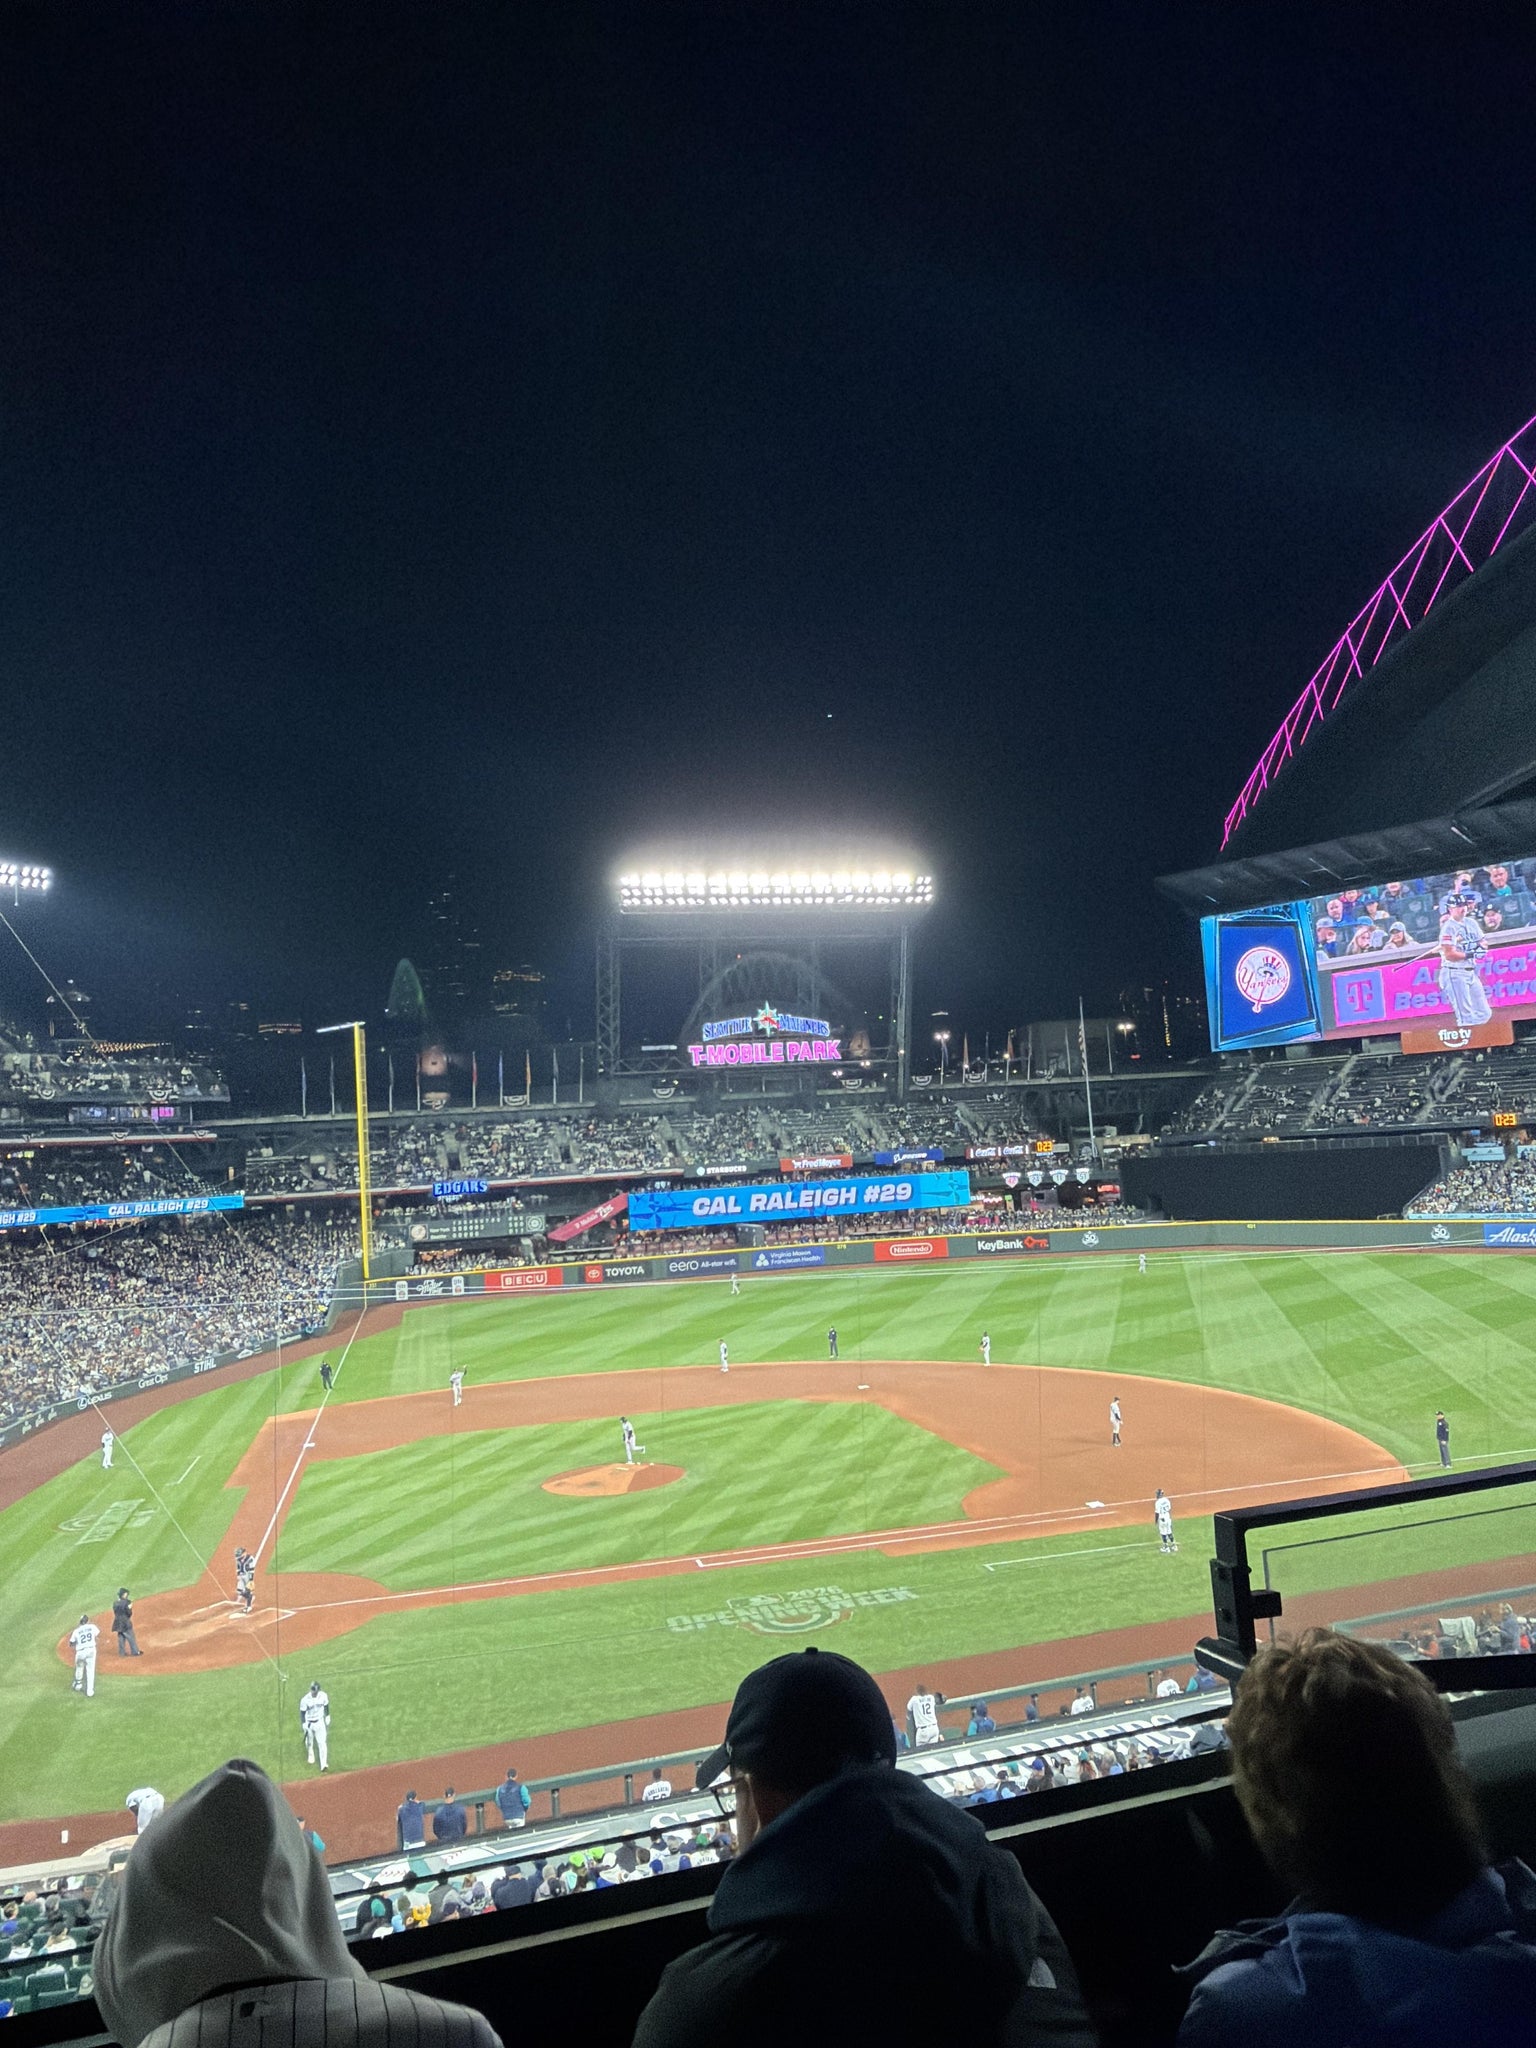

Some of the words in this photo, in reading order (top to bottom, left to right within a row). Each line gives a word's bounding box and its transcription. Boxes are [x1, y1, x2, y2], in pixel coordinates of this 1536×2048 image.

[703, 1016, 753, 1042] SEATTLE
[778, 1013, 831, 1037] MARINERS
[1438, 1028, 1457, 1041] fire
[1458, 1027, 1472, 1041] tv
[688, 1041, 785, 1067] T-MOBILE
[786, 1039, 842, 1064] PARK
[706, 1165, 748, 1175] STARBUCKS
[692, 1195, 742, 1216] CAL
[750, 1185, 857, 1212] RALEIGH
[863, 1182, 912, 1202] #29
[108, 1205, 132, 1216] CAL
[134, 1201, 183, 1214] RALEIGH
[186, 1200, 209, 1210] #29
[17, 1211, 37, 1223] #29
[893, 1245, 929, 1254] Nintendo
[977, 1238, 1023, 1252] KeyBank
[669, 1260, 699, 1273] eero
[770, 1257, 801, 1265] Franciscan
[605, 1265, 645, 1277] TOYOTA
[504, 1274, 545, 1286] BECU
[194, 1357, 217, 1374] STIHL
[80, 1632, 93, 1644] 29
[921, 1703, 932, 1715] 12
